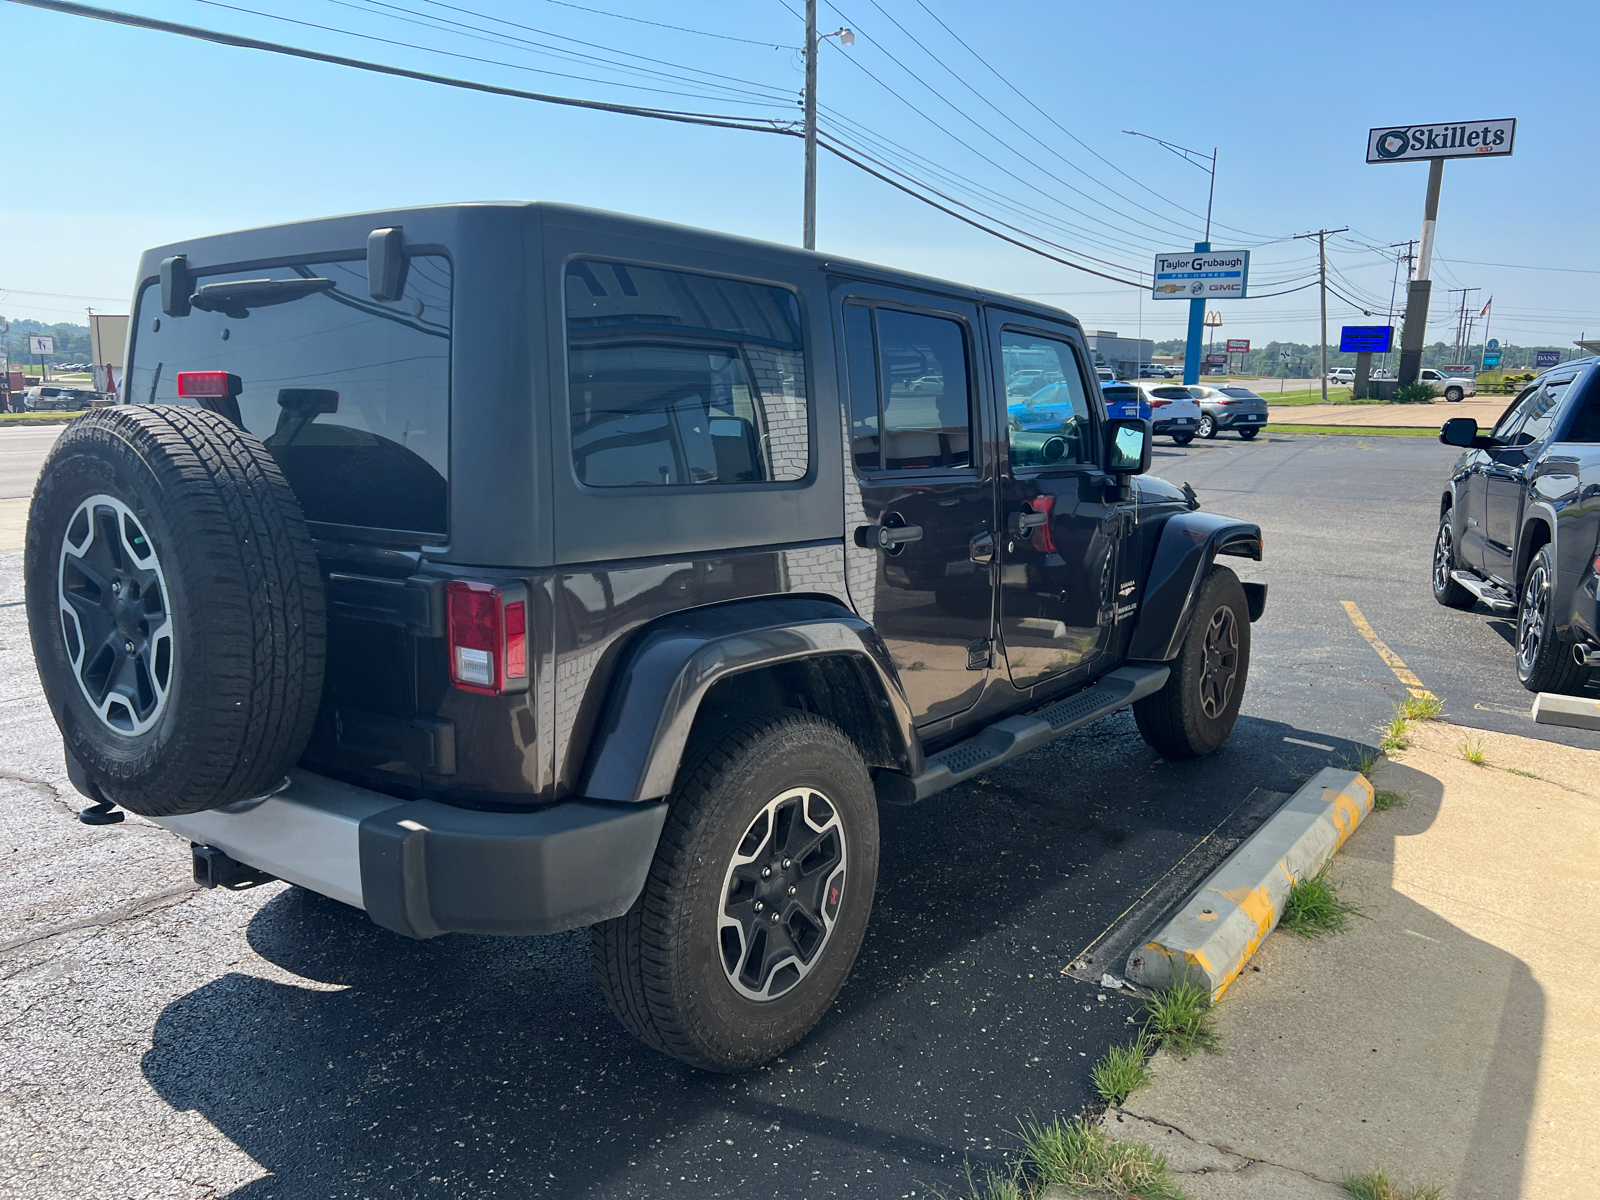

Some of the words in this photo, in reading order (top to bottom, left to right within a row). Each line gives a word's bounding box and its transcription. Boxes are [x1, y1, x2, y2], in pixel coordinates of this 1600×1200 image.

[1410, 126, 1505, 151] Skillets
[1159, 259, 1190, 271] Taylor
[1191, 257, 1242, 271] Grubaugh
[1120, 580, 1136, 590] SAHARA
[1118, 602, 1137, 614] RANGLER
[71, 726, 165, 778] YOKOHAMA
